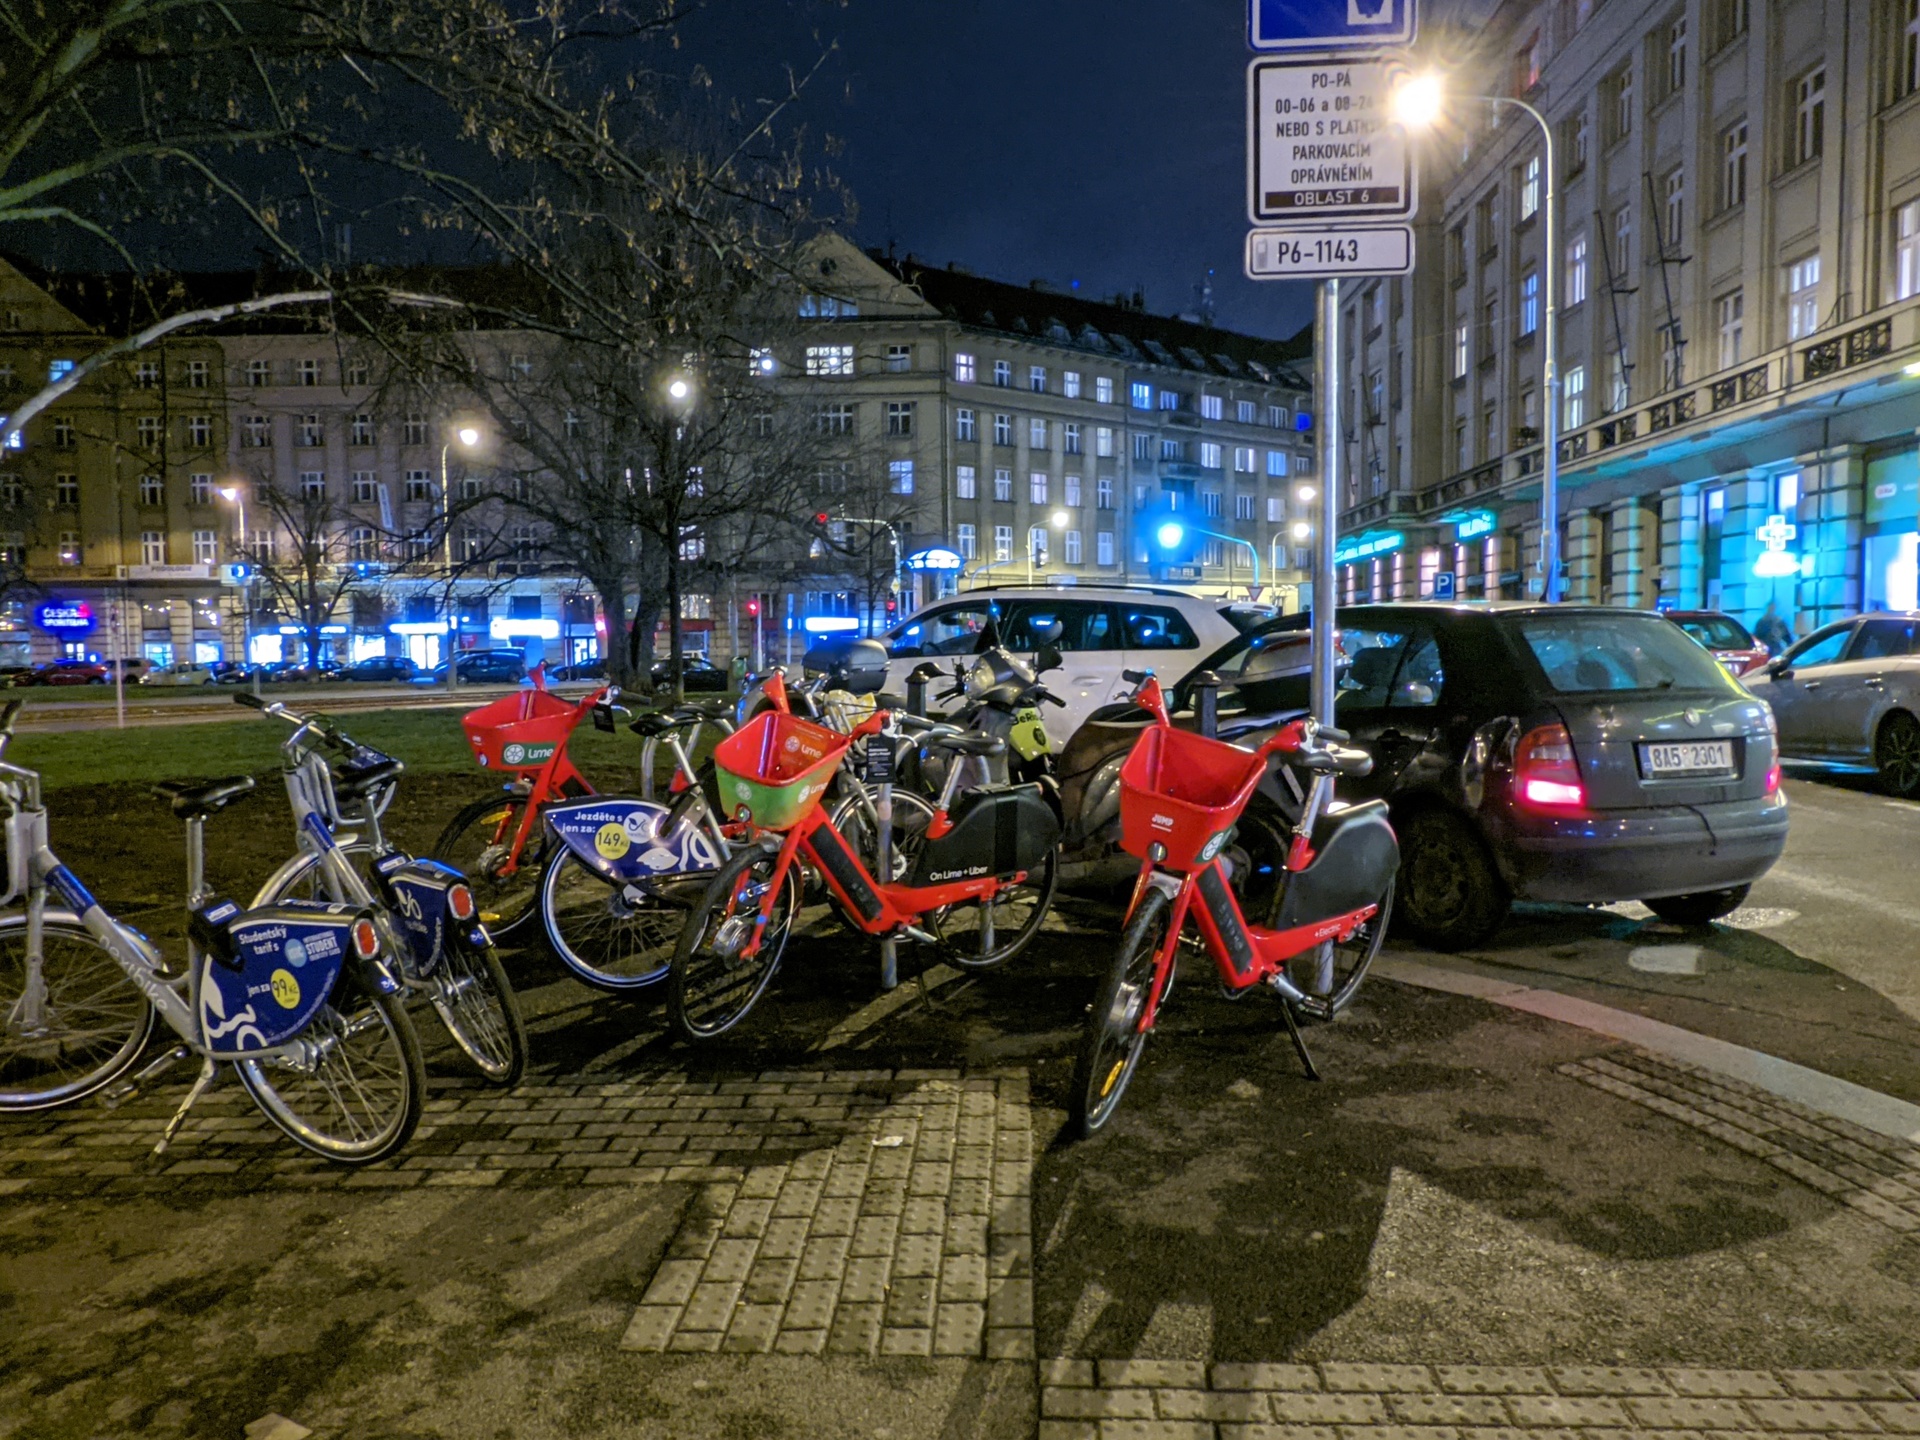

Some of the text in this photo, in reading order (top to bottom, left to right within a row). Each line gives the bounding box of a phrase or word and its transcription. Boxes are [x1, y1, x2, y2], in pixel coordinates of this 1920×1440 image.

[1312, 68, 1352, 89] PO-PÁ
[1275, 97, 1315, 114] 00-06
[1321, 101, 1329, 112] a
[1276, 121, 1309, 138] NEBO
[1316, 120, 1324, 137] S
[1292, 139, 1371, 161] PARKOVACÍM
[1291, 164, 1373, 184] OPRÁVNĚNÍM
[1294, 189, 1369, 206] OBLAST 6
[1278, 239, 1359, 265] P6-1143
[1437, 576, 1449, 592] P
[528, 747, 554, 759] Lime
[1652, 747, 1682, 768] 8A5
[574, 811, 616, 822] Jezděte
[1152, 814, 1174, 827] JUMP
[561, 822, 579, 834] jen
[598, 831, 621, 847] 149
[930, 871, 943, 881] On
[943, 869, 963, 880] Lime
[969, 865, 988, 876] Uber
[239, 925, 287, 944] Studentský
[253, 940, 273, 955] tarif
[273, 942, 280, 952] s
[305, 937, 338, 955] STUDENT
[272, 978, 287, 998] 99
